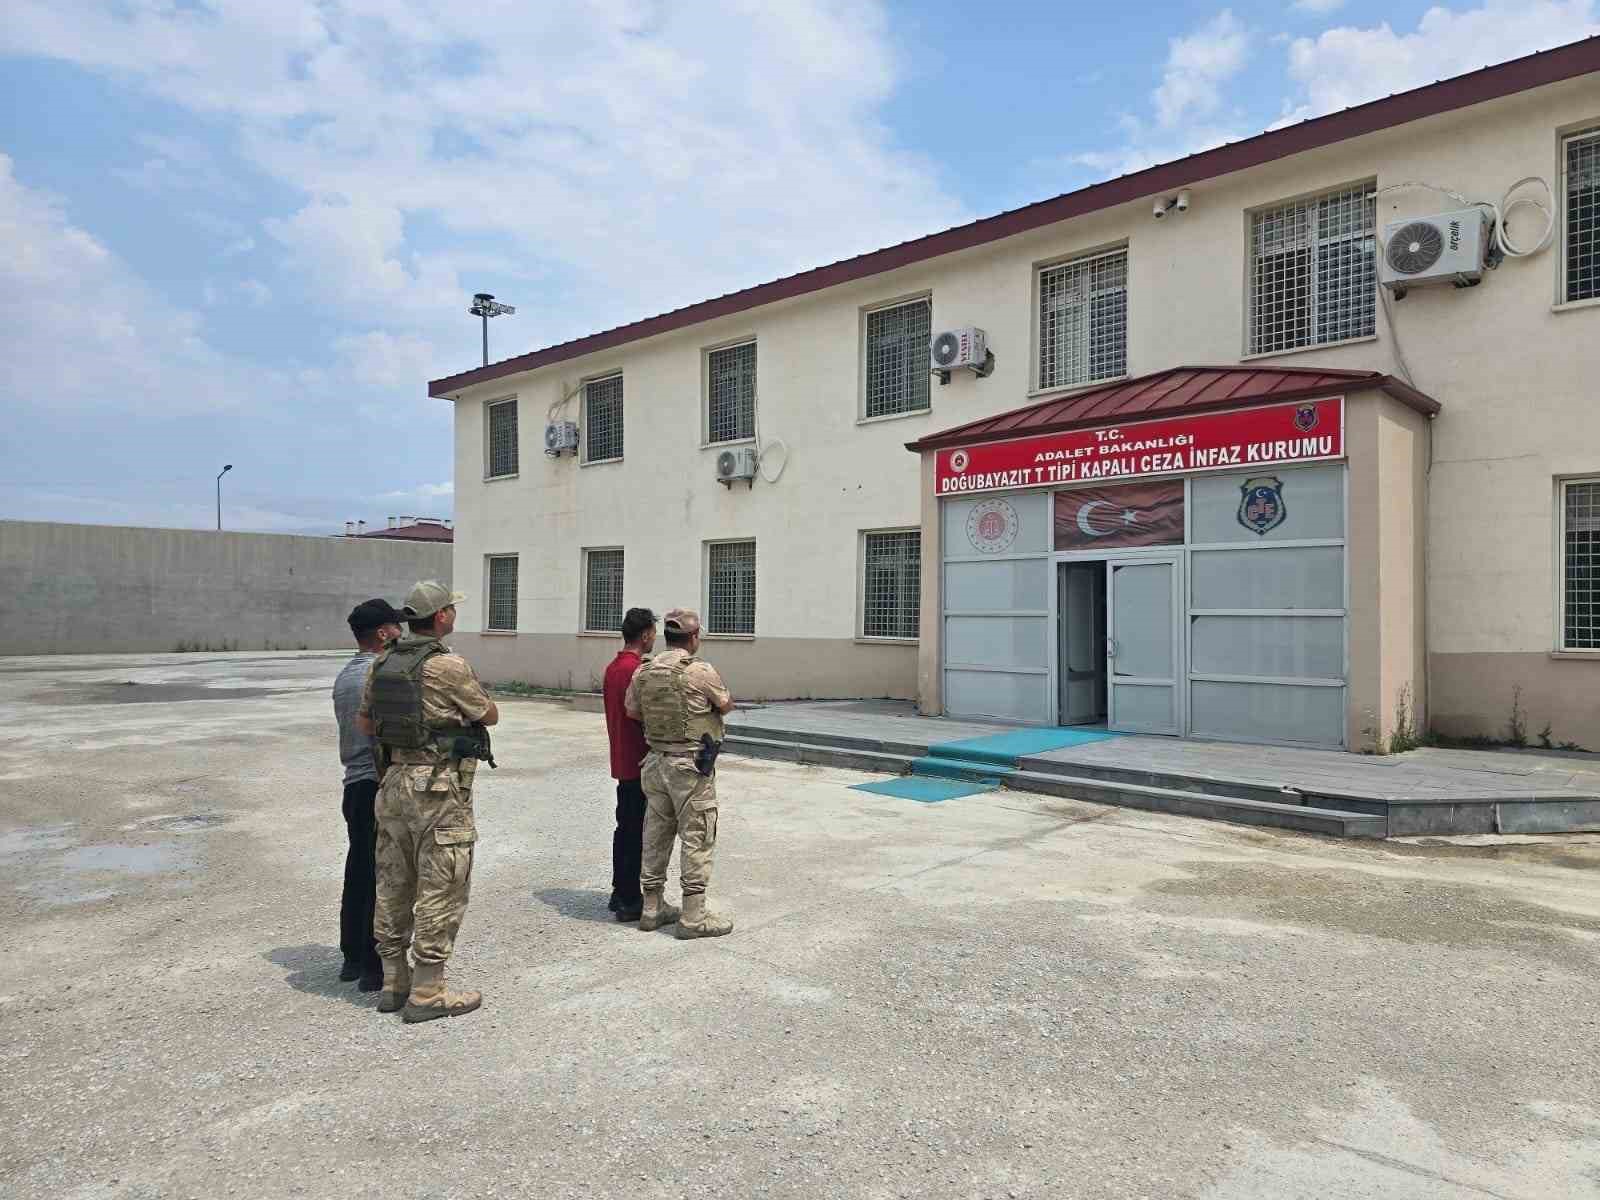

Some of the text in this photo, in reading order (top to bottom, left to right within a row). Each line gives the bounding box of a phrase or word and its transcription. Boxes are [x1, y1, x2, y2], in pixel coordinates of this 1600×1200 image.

[1034, 434, 1194, 462] ADALET BAKANLIĞI
[1095, 429, 1125, 442] T.C.
[941, 436, 1332, 492] DOĞUBAYAZIT T TİPİ KAPALI CEZA İNFAZ KURUMU
